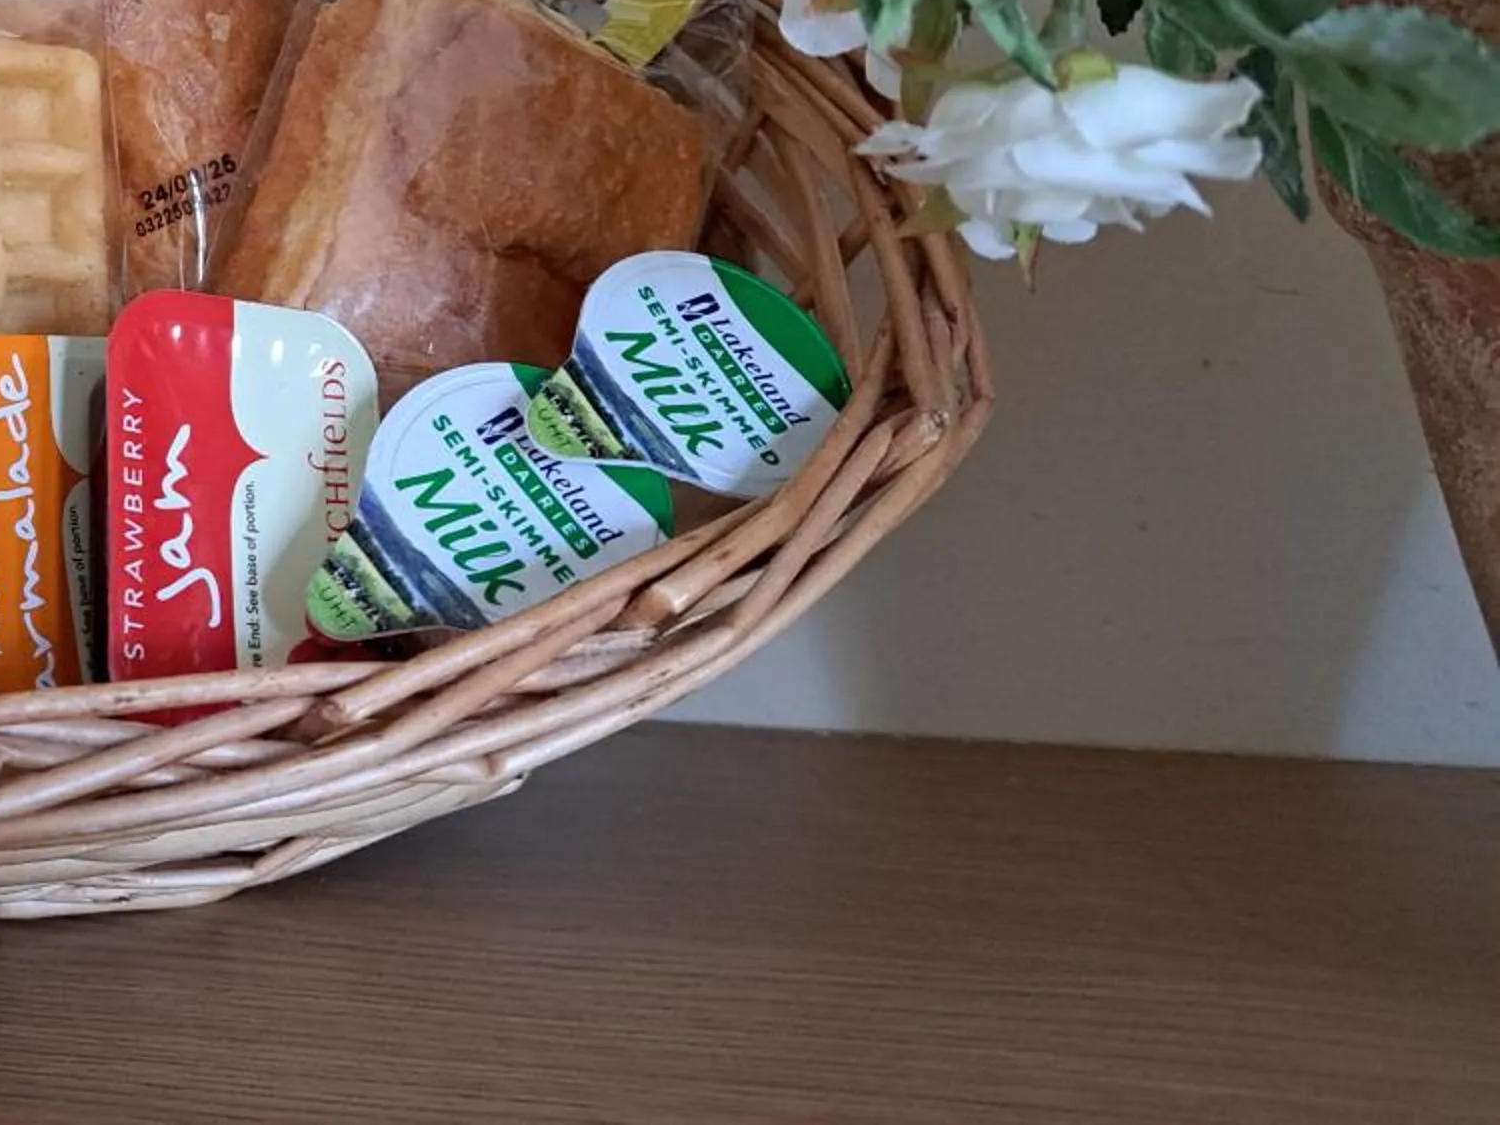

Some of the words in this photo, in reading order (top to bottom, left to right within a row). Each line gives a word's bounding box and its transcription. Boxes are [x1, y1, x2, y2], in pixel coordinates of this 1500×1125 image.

[604, 331, 725, 457] Milk
[638, 286, 780, 466] SEMI-SKIMMED
[699, 330, 779, 426] DAIRIES
[710, 317, 811, 426] Lakeland
[538, 408, 572, 448] UHT
[121, 388, 145, 660] STRAWBERRY
[154, 423, 221, 629] Jam
[242, 481, 260, 533] portion.
[394, 468, 527, 605] Milk
[433, 414, 576, 585] SEMI-SKIMME
[501, 451, 590, 551] DAIRIES
[516, 434, 624, 546] Lakeland
[242, 537, 257, 551] of
[243, 555, 258, 586] base
[245, 590, 259, 616] See
[246, 618, 262, 648] End:
[318, 586, 357, 629] UHT
